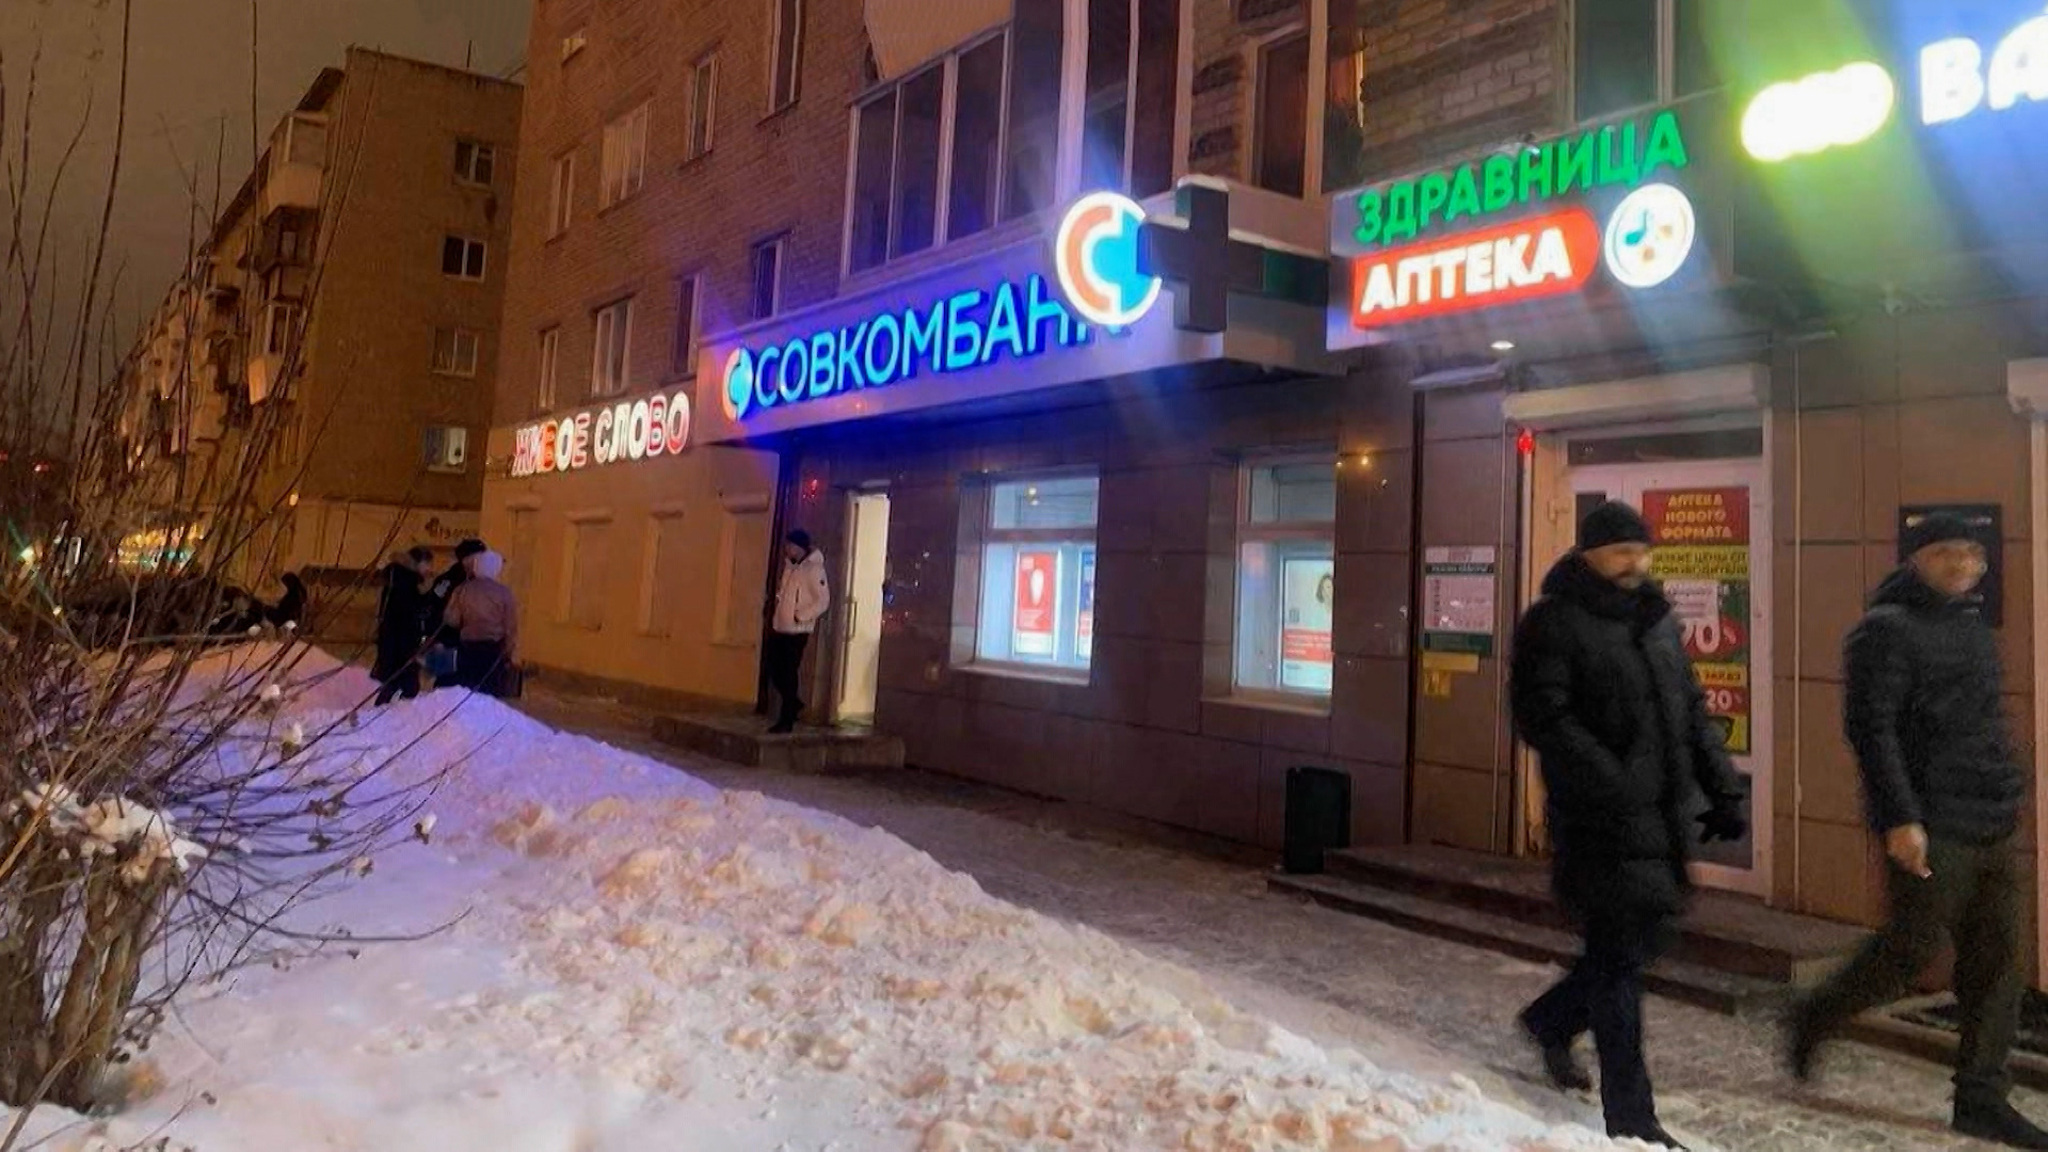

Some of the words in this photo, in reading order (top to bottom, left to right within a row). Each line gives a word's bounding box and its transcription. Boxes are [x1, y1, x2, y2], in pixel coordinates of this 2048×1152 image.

[1354, 110, 1687, 246] ЗДРАВНИЦА
[1360, 226, 1573, 314] АПТЕКА
[511, 412, 591, 477] ЖИВОЕ
[594, 391, 690, 464] СЛОВО
[1665, 509, 1727, 523] НОВОГО
[1667, 494, 1723, 508] АПТЕКА
[1660, 526, 1733, 539] ФОРМАТА
